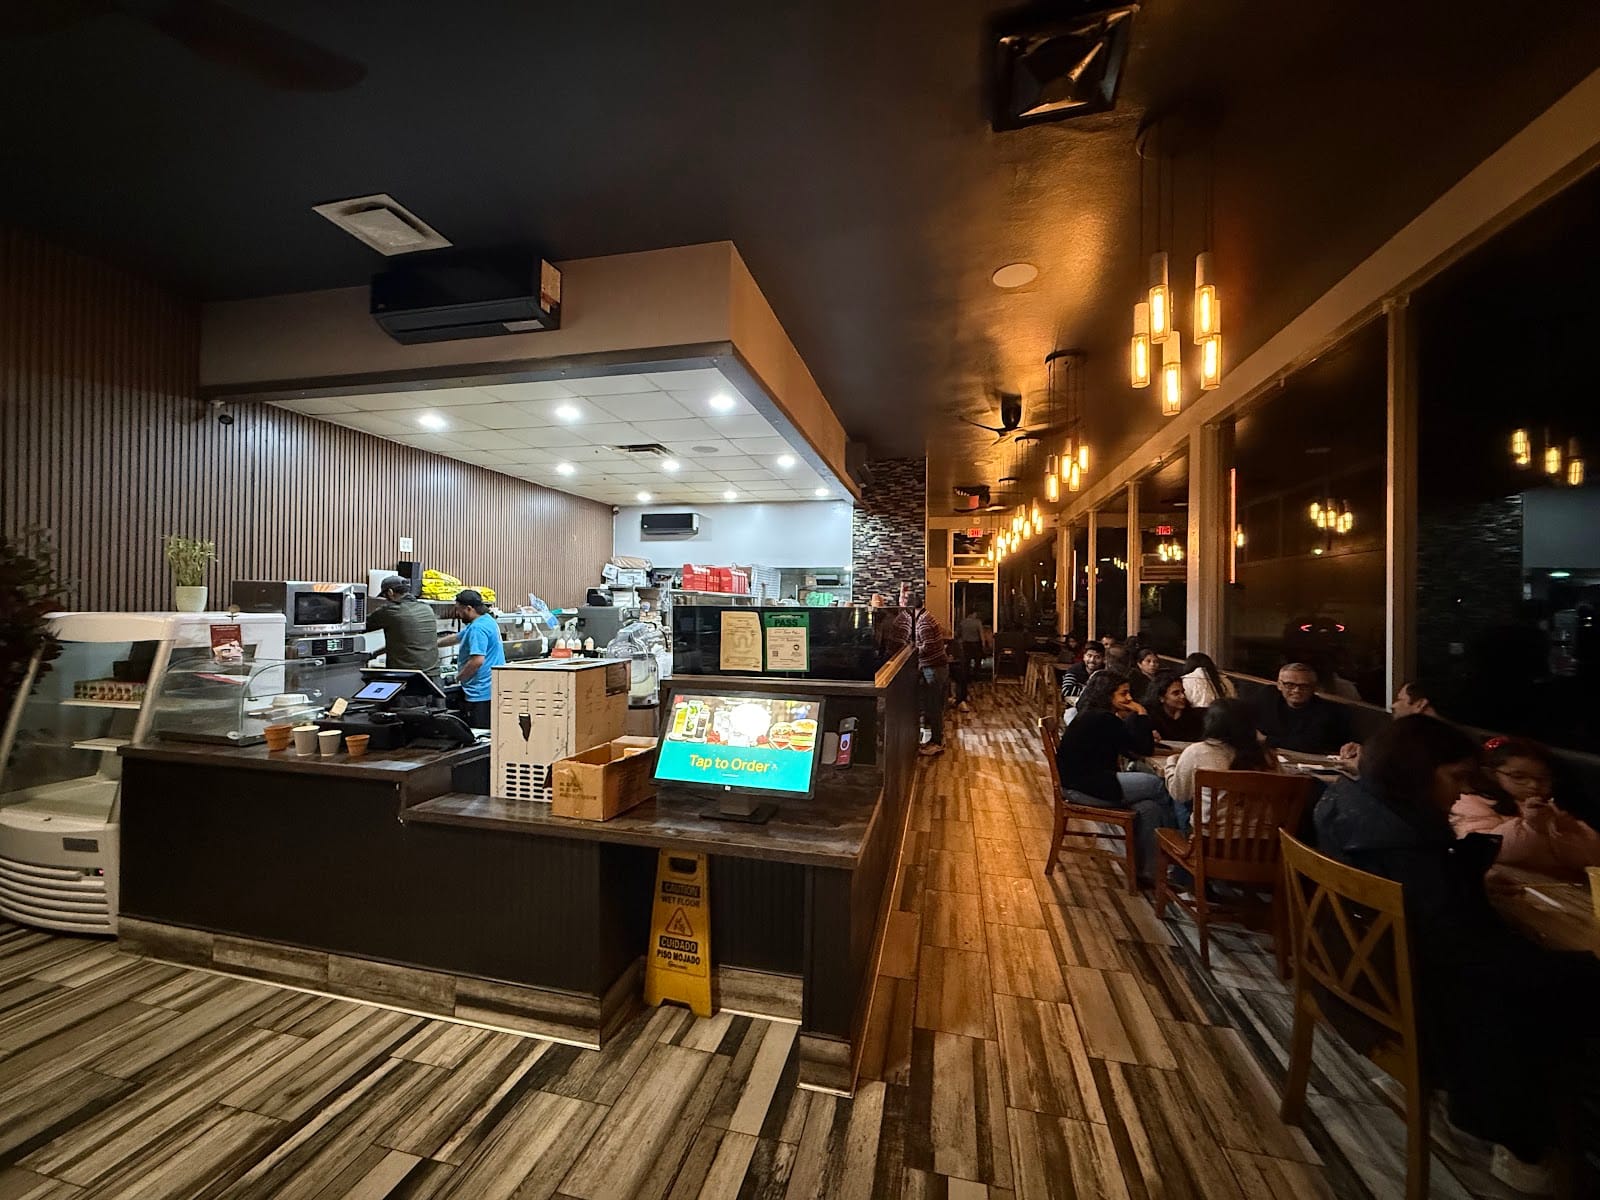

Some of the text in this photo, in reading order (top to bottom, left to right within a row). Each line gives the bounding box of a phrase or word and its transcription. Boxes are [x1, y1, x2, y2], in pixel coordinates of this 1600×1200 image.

[774, 619, 798, 627] PASS
[690, 755, 770, 773] Tap to Order
[664, 882, 698, 897] CAUTION
[661, 895, 700, 907] WET FLOOR
[660, 936, 697, 953] CUIDADO
[657, 949, 701, 965] PISO MOJADO
